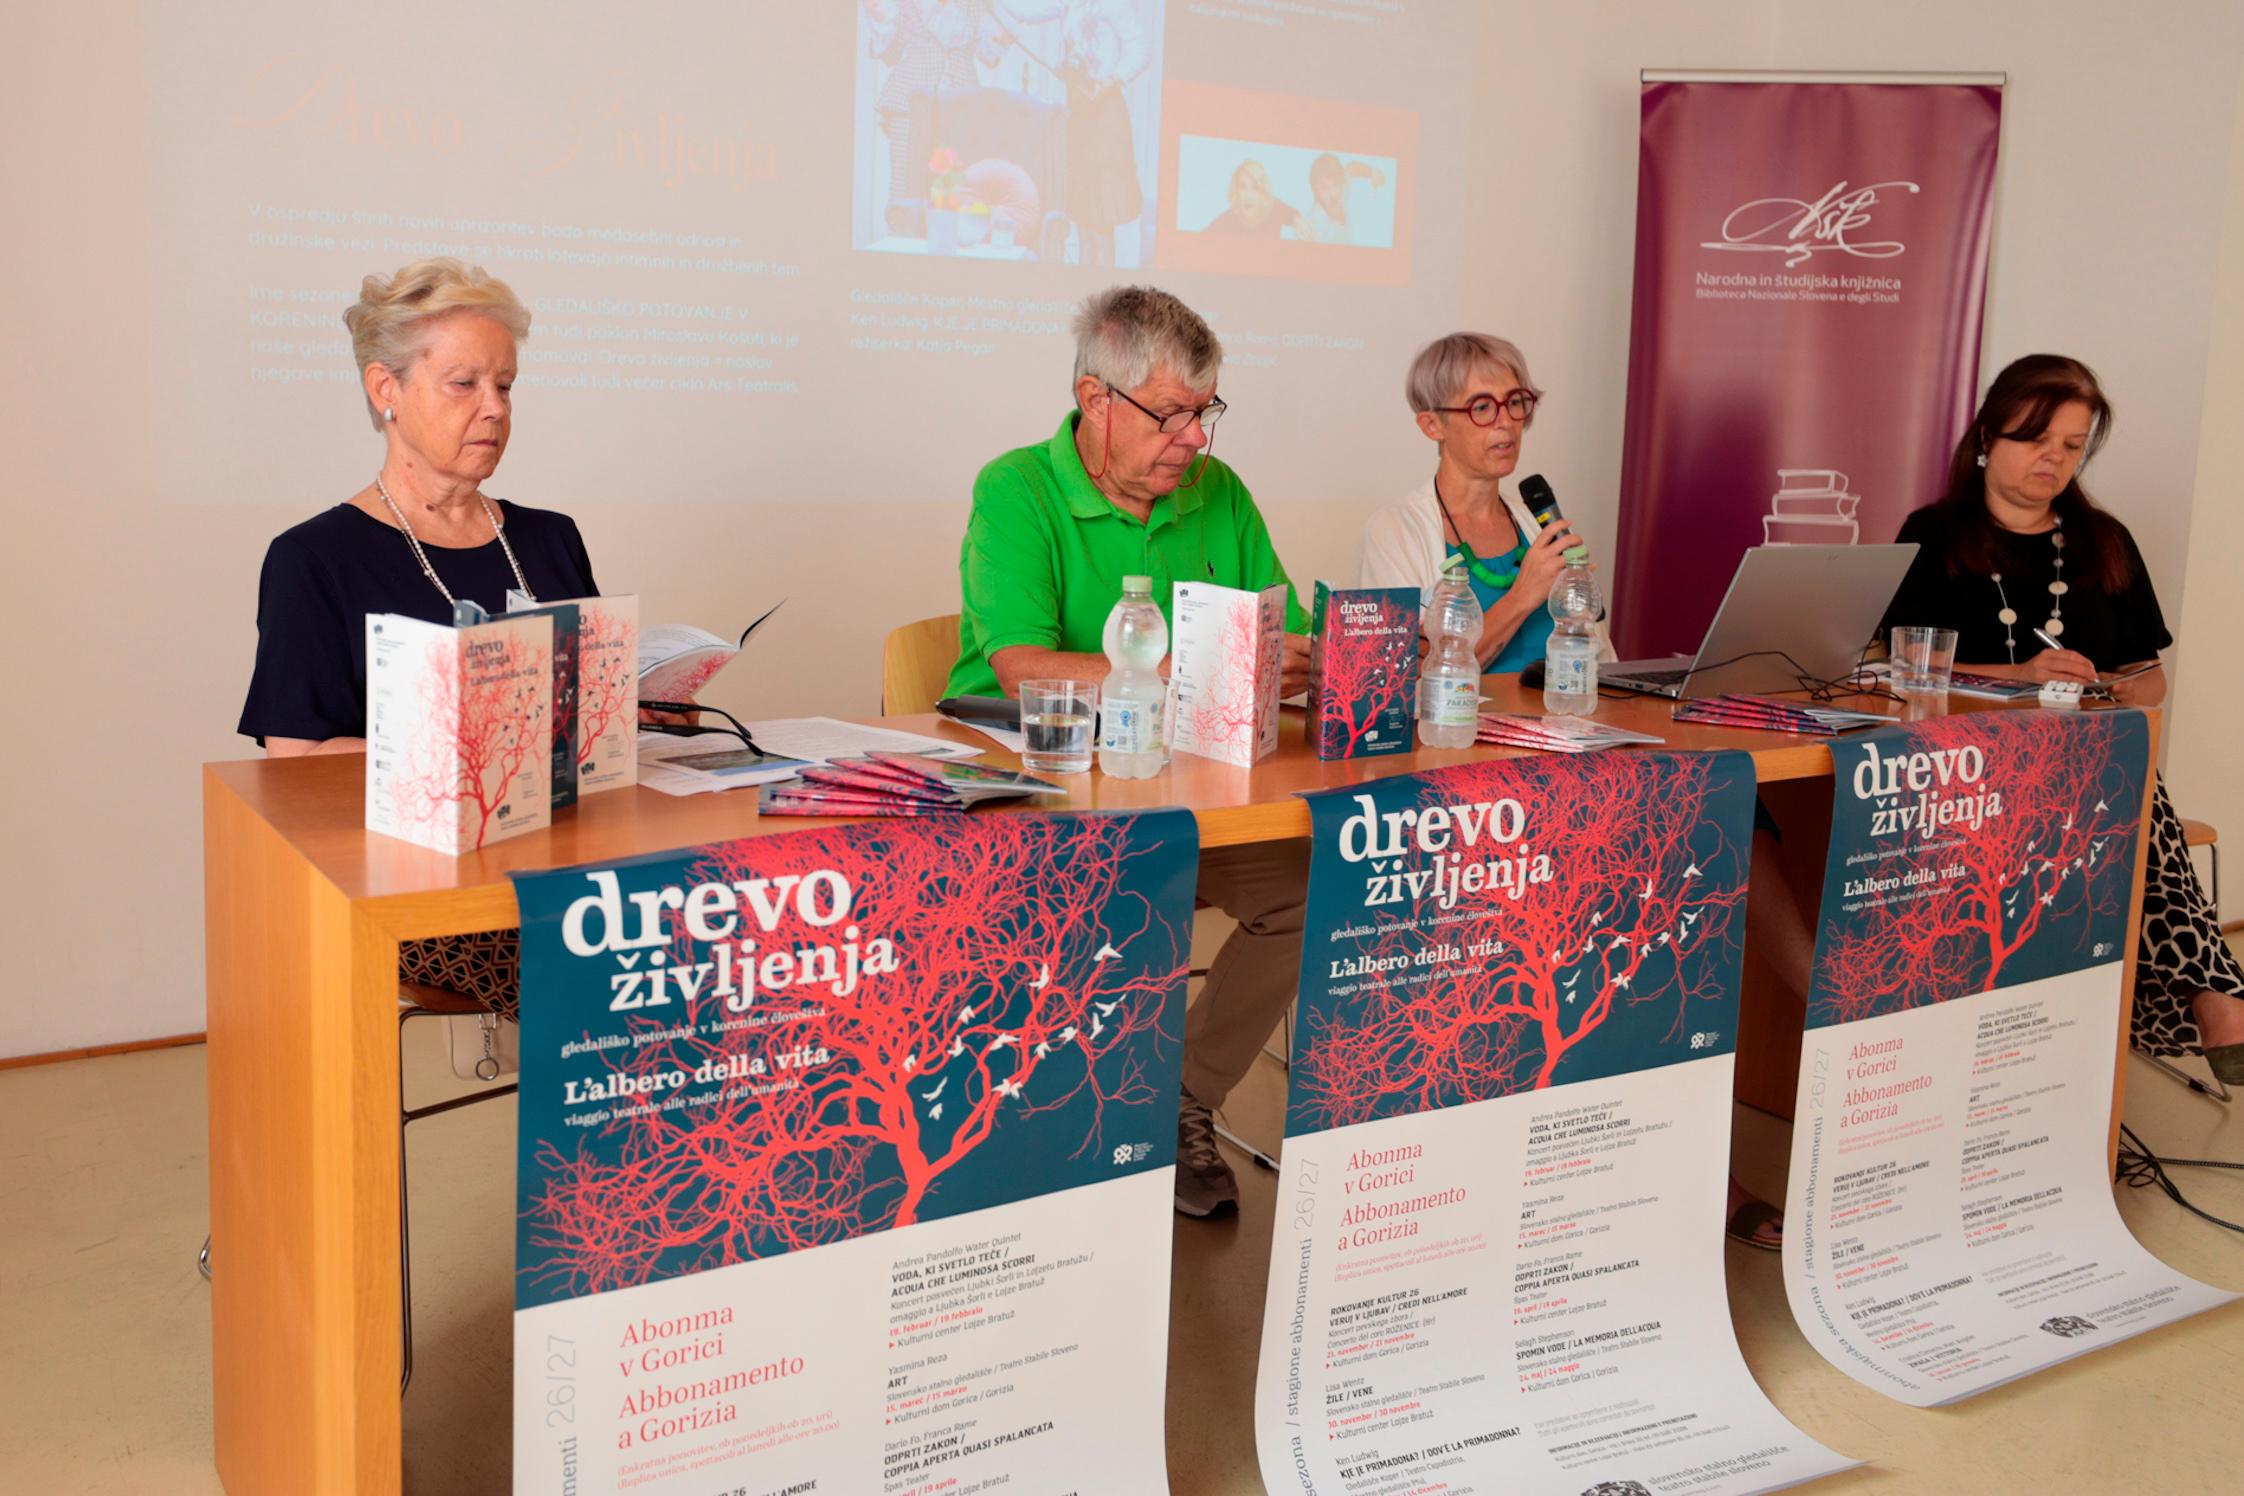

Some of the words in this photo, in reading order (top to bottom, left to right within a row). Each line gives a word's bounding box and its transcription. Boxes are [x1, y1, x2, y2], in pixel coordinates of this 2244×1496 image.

[1696, 272, 1757, 286] Narodna
[1759, 273, 1772, 286] in
[1775, 273, 1838, 290] študijska
[1840, 274, 1901, 292] knjižnica
[1696, 289, 1747, 299] Biblioteca
[1748, 289, 1797, 300] Nazionale
[1799, 290, 1838, 301] Slovena
[1839, 293, 1846, 301] e
[1847, 291, 1871, 305] degli
[1873, 291, 1900, 302] Studi
[1340, 601, 1377, 614] drevo
[465, 640, 504, 658] drevo
[1853, 742, 1984, 800] drevo
[1339, 794, 1526, 863] drevo
[1870, 783, 2003, 839] življenja
[1364, 843, 1554, 910] življenja
[1843, 875, 1900, 897] L'albero
[1903, 867, 1937, 887] della
[1940, 863, 1966, 880] vita
[562, 869, 852, 957] drevo
[609, 925, 900, 1013] življenja
[1329, 951, 1409, 979] L'albero
[1414, 943, 1462, 966] della
[1467, 938, 1504, 957] vita
[561, 1035, 630, 1058] gledališko
[633, 1026, 697, 1048] potovanje
[700, 1024, 709, 1034] v
[711, 1015, 768, 1033] korenine
[770, 1007, 826, 1023] človeštva
[1848, 1038, 1904, 1061] Abonma
[563, 1070, 686, 1105] L'albero
[694, 1054, 767, 1084] della
[774, 1044, 831, 1070] vita
[1810, 1048, 1830, 1110] 26/27
[1847, 1068, 1855, 1081] v
[1856, 1054, 1897, 1079] Gorici
[564, 1108, 610, 1128] viaggio
[613, 1102, 661, 1119] teatrale
[663, 1096, 686, 1111] alle
[689, 1090, 724, 1107] radici
[1842, 1075, 1933, 1108] Abbonamento
[1840, 1115, 1848, 1129] a
[1850, 1101, 1898, 1126] Gorizia
[1346, 1144, 1422, 1172] Abonma
[1294, 1158, 1319, 1230] 26/27
[1344, 1181, 1354, 1195] v
[1358, 1163, 1414, 1192] Gorici
[1340, 1187, 1466, 1227] Abbonamento
[892, 1257, 924, 1270] Andrea
[926, 1247, 964, 1262] Pandolfo
[965, 1241, 990, 1253] Water
[991, 1232, 1022, 1248] Quintet
[1337, 1236, 1348, 1251] a
[1352, 1218, 1419, 1247] Gorizia
[890, 1295, 924, 1310] Koncert
[925, 1286, 965, 1304] posvečen
[967, 1278, 994, 1292] Ljubki
[996, 1271, 1014, 1285] Šorli
[1016, 1271, 1025, 1279] in
[1026, 1263, 1055, 1277] Lojzetu
[1056, 1254, 1089, 1269] Bratužu
[891, 1281, 925, 1297] ACQUA
[927, 1276, 945, 1289] CHE
[949, 1263, 999, 1283] LUMINOSA
[1001, 1254, 1035, 1271] SCORRI
[892, 1269, 922, 1283] VODA,
[925, 1265, 936, 1276] KI
[938, 1255, 976, 1273] SVETLO
[978, 1249, 1001, 1263] TEČE
[889, 1308, 927, 1324] omaggio
[927, 1306, 934, 1314] a
[935, 1298, 966, 1313] Ljubka
[966, 1292, 986, 1305] Šorli
[987, 1291, 993, 1299] e
[995, 1285, 1017, 1297] Lojze
[1018, 1276, 1045, 1292] Bratuž
[1291, 1237, 1312, 1349] abbonamenti
[1329, 1315, 1353, 1327] VERUJ
[1362, 1306, 1390, 1320] LJUBAV
[1397, 1298, 1420, 1311] CREDI
[1330, 1299, 1374, 1315] ROKOVANJE
[1377, 1291, 1407, 1305] KULTUR
[1409, 1288, 1419, 1297] 26
[621, 1307, 733, 1347] Abonma
[897, 1331, 934, 1347] Kulturni
[934, 1324, 961, 1338] center
[963, 1318, 986, 1331] Lojze
[987, 1309, 1015, 1324] Bratuž
[1516, 1346, 1546, 1361] SPOMIN
[1546, 1342, 1566, 1353] VODE
[1573, 1338, 1583, 1348] LA
[1584, 1330, 1619, 1345] MEMORIA
[619, 1360, 634, 1377] v
[641, 1332, 723, 1372] Gorici
[888, 1359, 925, 1376] Yasmina
[927, 1353, 948, 1366] Reza
[546, 1335, 576, 1428] 26/27
[619, 1357, 804, 1418] Abbonamento
[887, 1376, 907, 1389] ART
[1287, 1347, 1302, 1416] stagione
[1326, 1392, 1343, 1405] ŽILE
[1352, 1386, 1373, 1398] VENE
[618, 1431, 632, 1449] a
[640, 1401, 737, 1443] Gorizia
[884, 1439, 908, 1452] Dario
[910, 1435, 922, 1445] Fo,
[923, 1426, 952, 1441] Franca
[953, 1419, 977, 1432] Rame
[884, 1461, 920, 1479] COPPIA
[923, 1449, 960, 1467] APERTA
[962, 1439, 991, 1456] QUASI
[994, 1421, 1054, 1447] SPALANCATA
[884, 1447, 921, 1465] ODPRTI
[923, 1436, 958, 1454] ZAKON
[1339, 1468, 1355, 1479] KJE
[1355, 1465, 1364, 1477] JE
[1365, 1451, 1419, 1472] PRIMADONA?
[1451, 1441, 1464, 1451] LA
[1463, 1426, 1520, 1448] PRIMADONNA?
[1649, 1467, 1703, 1485] slovensko
[1703, 1458, 1737, 1471] stalno
[1737, 1446, 1790, 1463] gledališče
